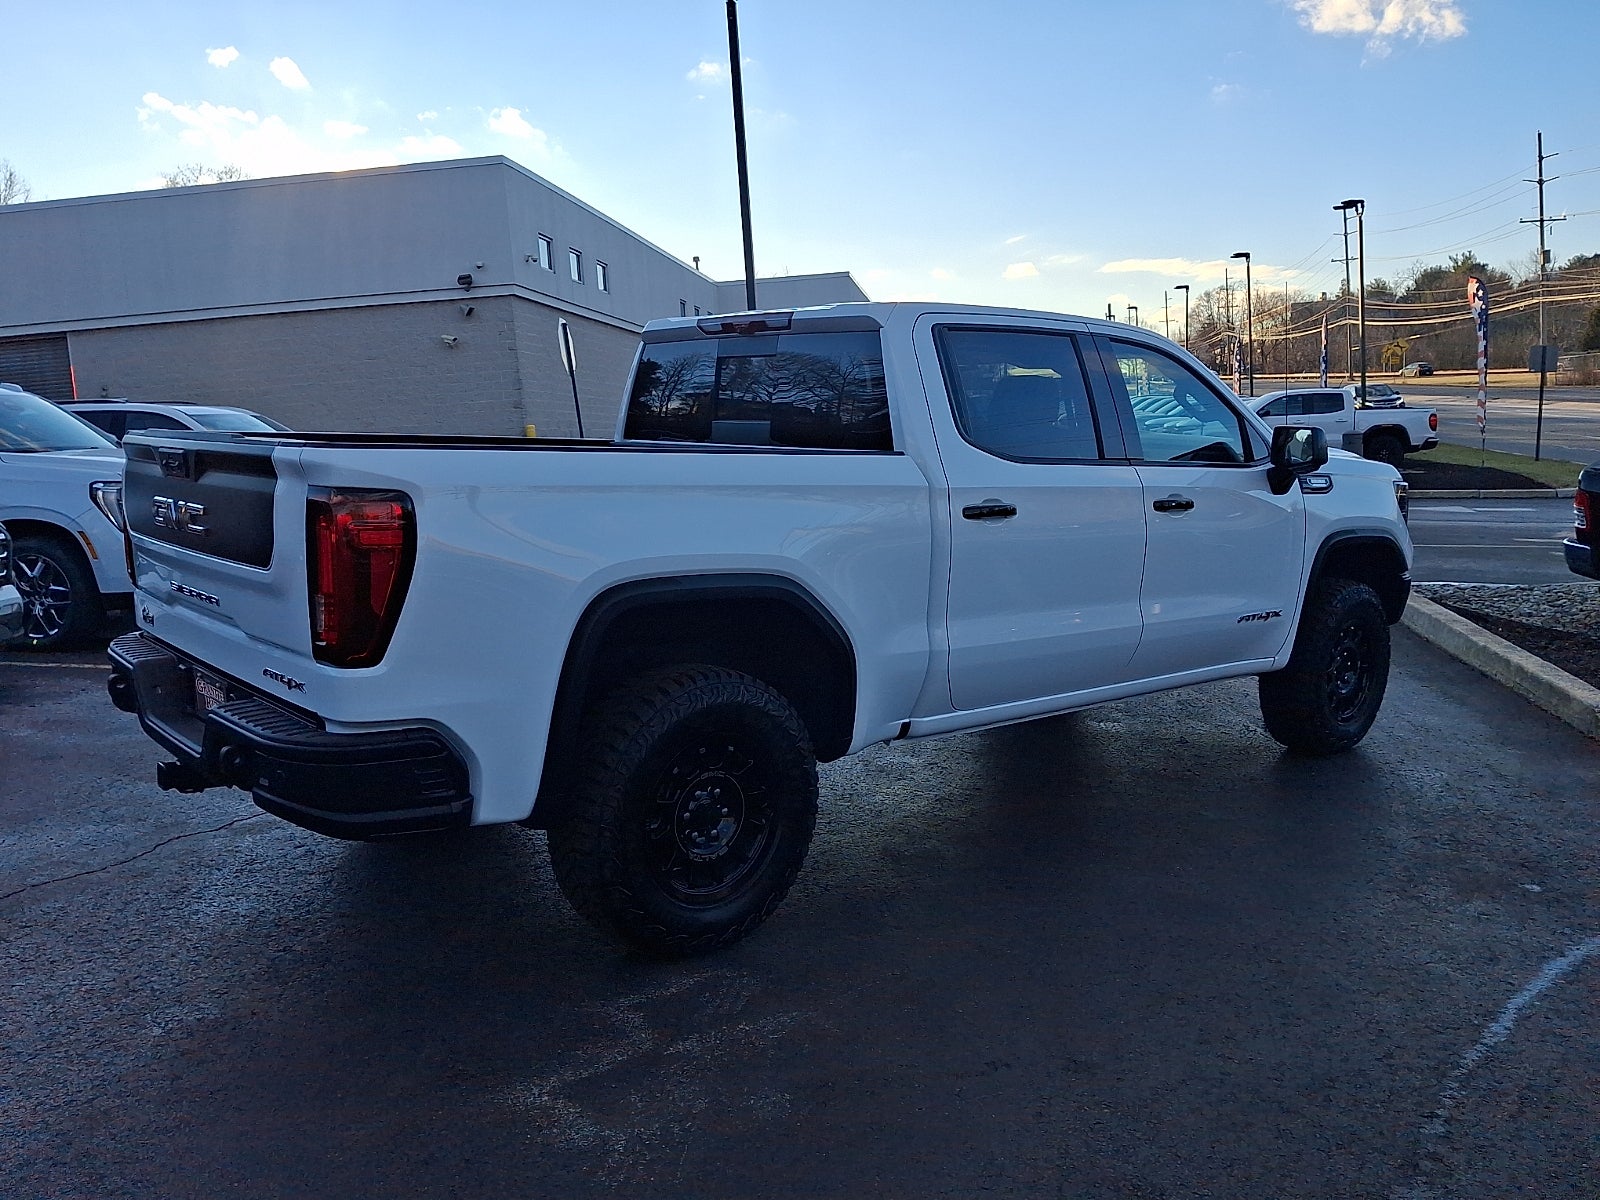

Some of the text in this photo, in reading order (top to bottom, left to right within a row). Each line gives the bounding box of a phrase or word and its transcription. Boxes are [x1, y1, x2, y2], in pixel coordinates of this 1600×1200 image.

[152, 495, 208, 536] GMC
[169, 580, 221, 607] SIERRA
[1237, 609, 1283, 624] AT4X
[262, 667, 307, 695] AT4X
